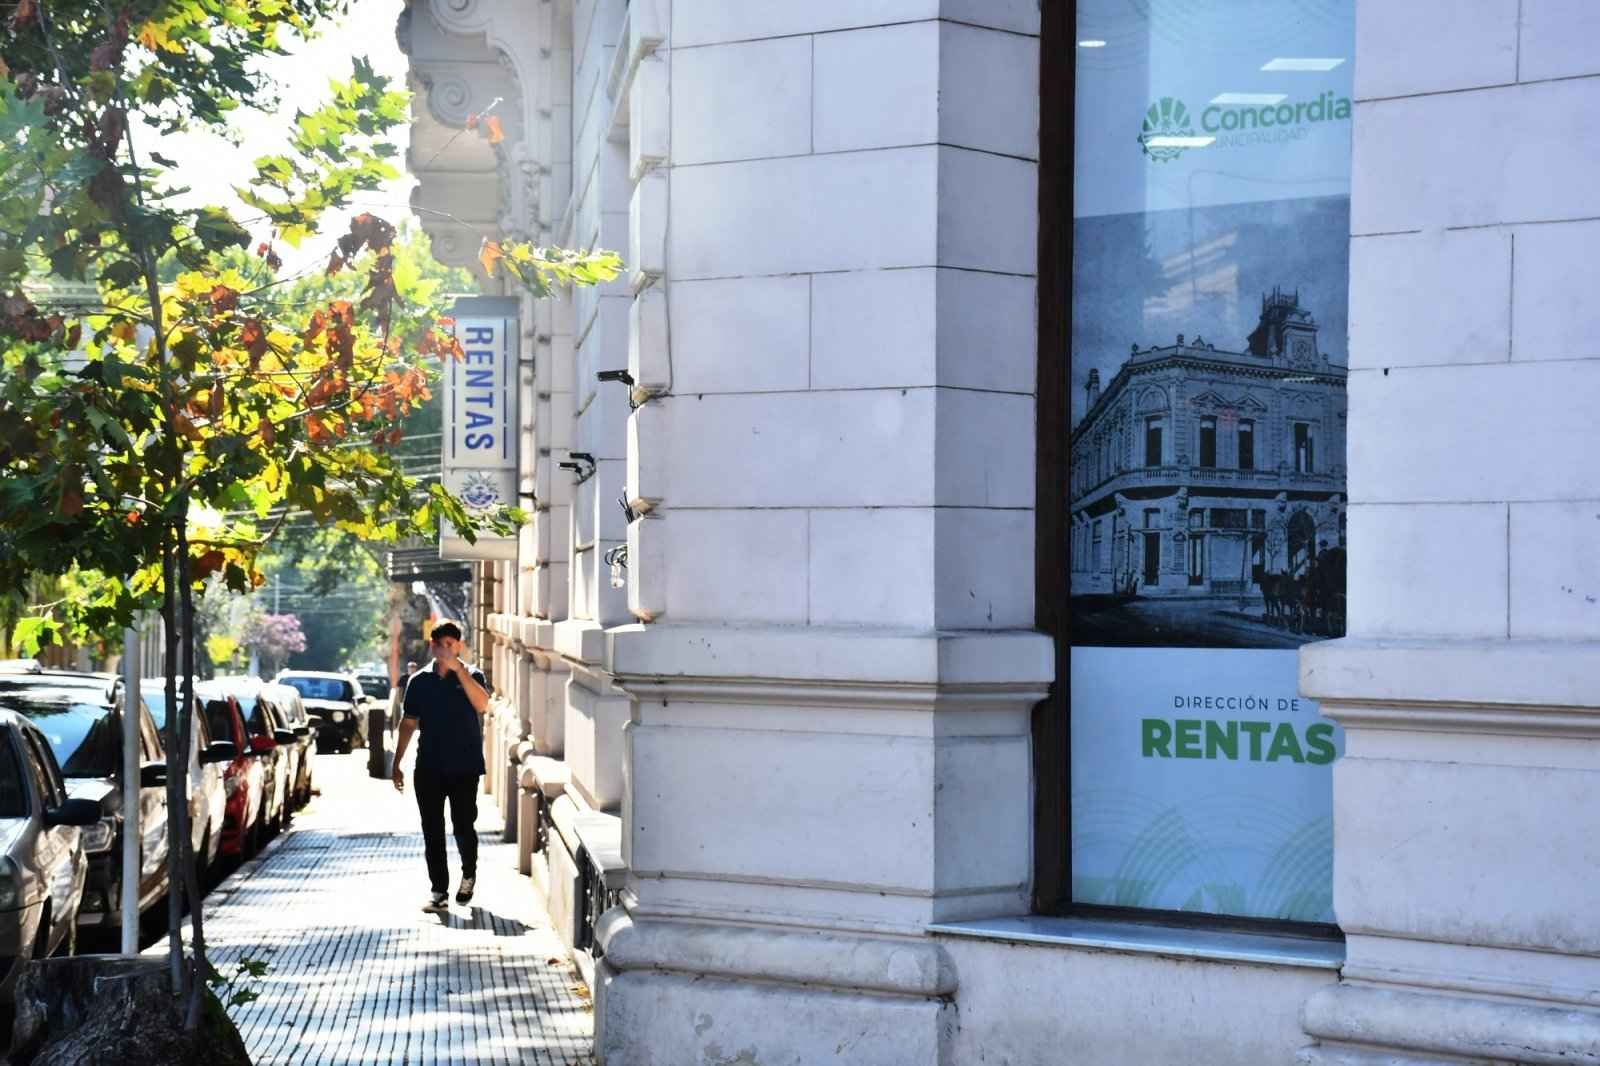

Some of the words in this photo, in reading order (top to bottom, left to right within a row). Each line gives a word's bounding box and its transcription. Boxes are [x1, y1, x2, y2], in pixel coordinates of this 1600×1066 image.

[1201, 91, 1351, 133] Concordia
[465, 327, 494, 449] RENTAS
[1174, 695, 1269, 711] DIRECCIÓN
[1277, 698, 1300, 712] DE
[1141, 718, 1336, 765] RENTAS
